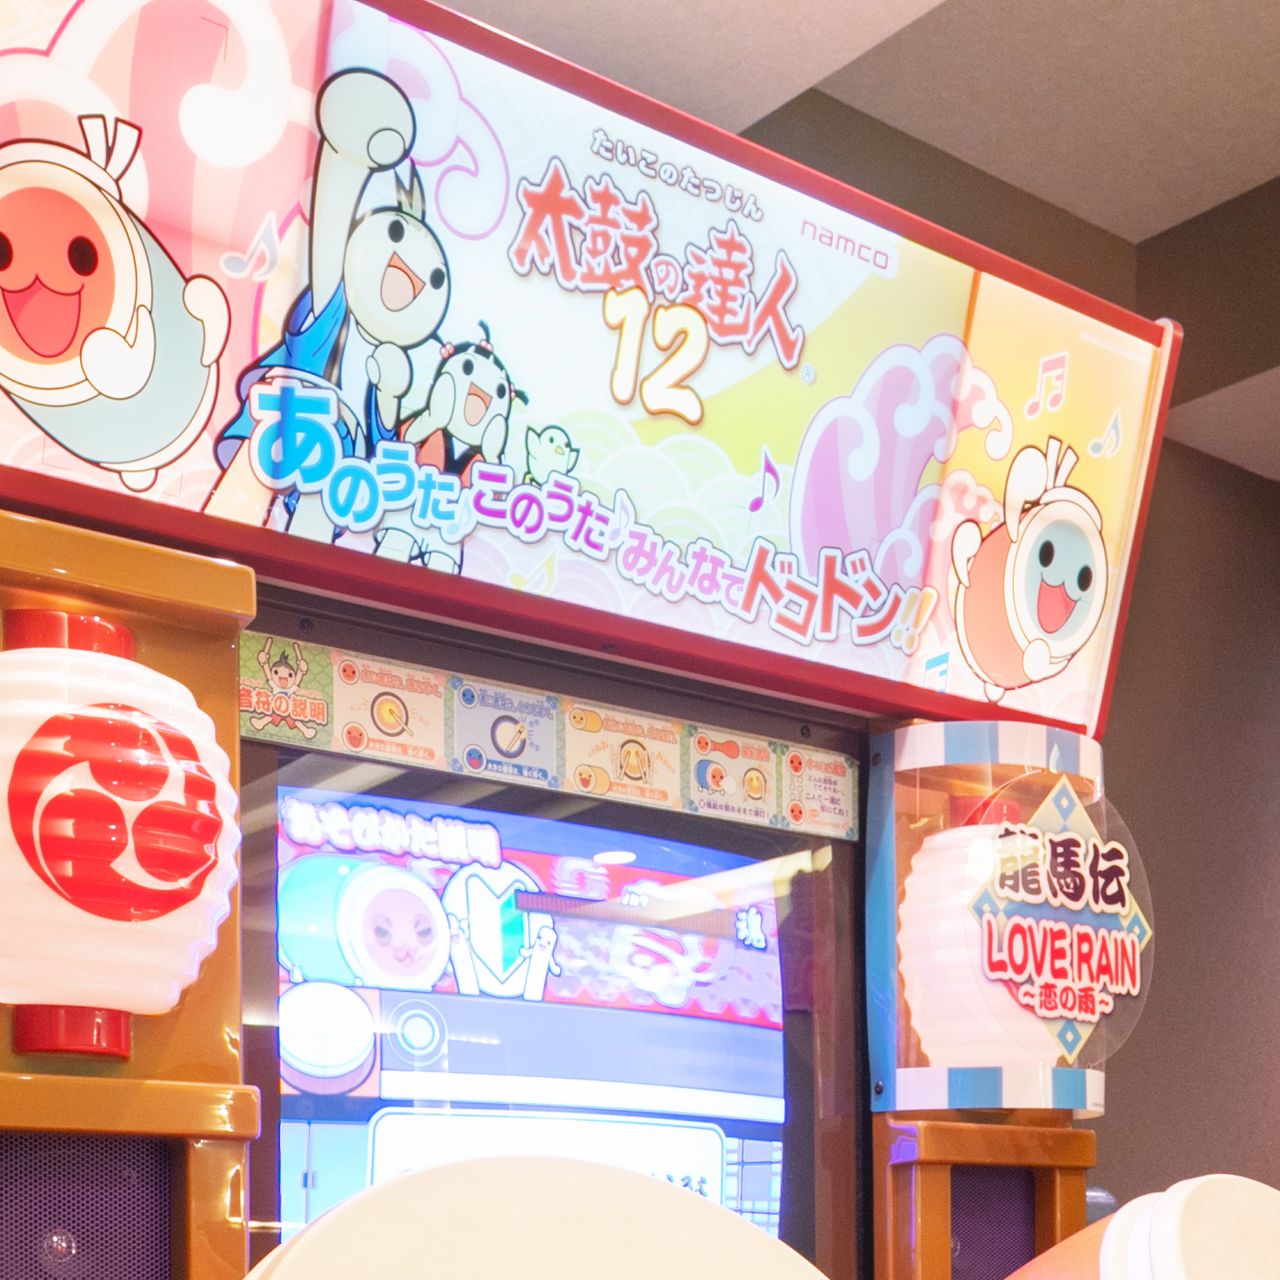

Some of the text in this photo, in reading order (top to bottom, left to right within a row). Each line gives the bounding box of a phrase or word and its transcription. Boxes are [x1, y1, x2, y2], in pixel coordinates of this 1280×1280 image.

[591, 128, 764, 222] たいこのたつじん
[511, 158, 803, 368] 太鼓の達人
[800, 218, 890, 272] namco
[603, 286, 704, 425] 12
[254, 382, 459, 525] あのうた
[471, 467, 612, 554] このうた
[240, 686, 327, 724] 音符の説明
[998, 829, 1127, 909] 龍馬伝
[985, 918, 1138, 991] LOVE RAIN
